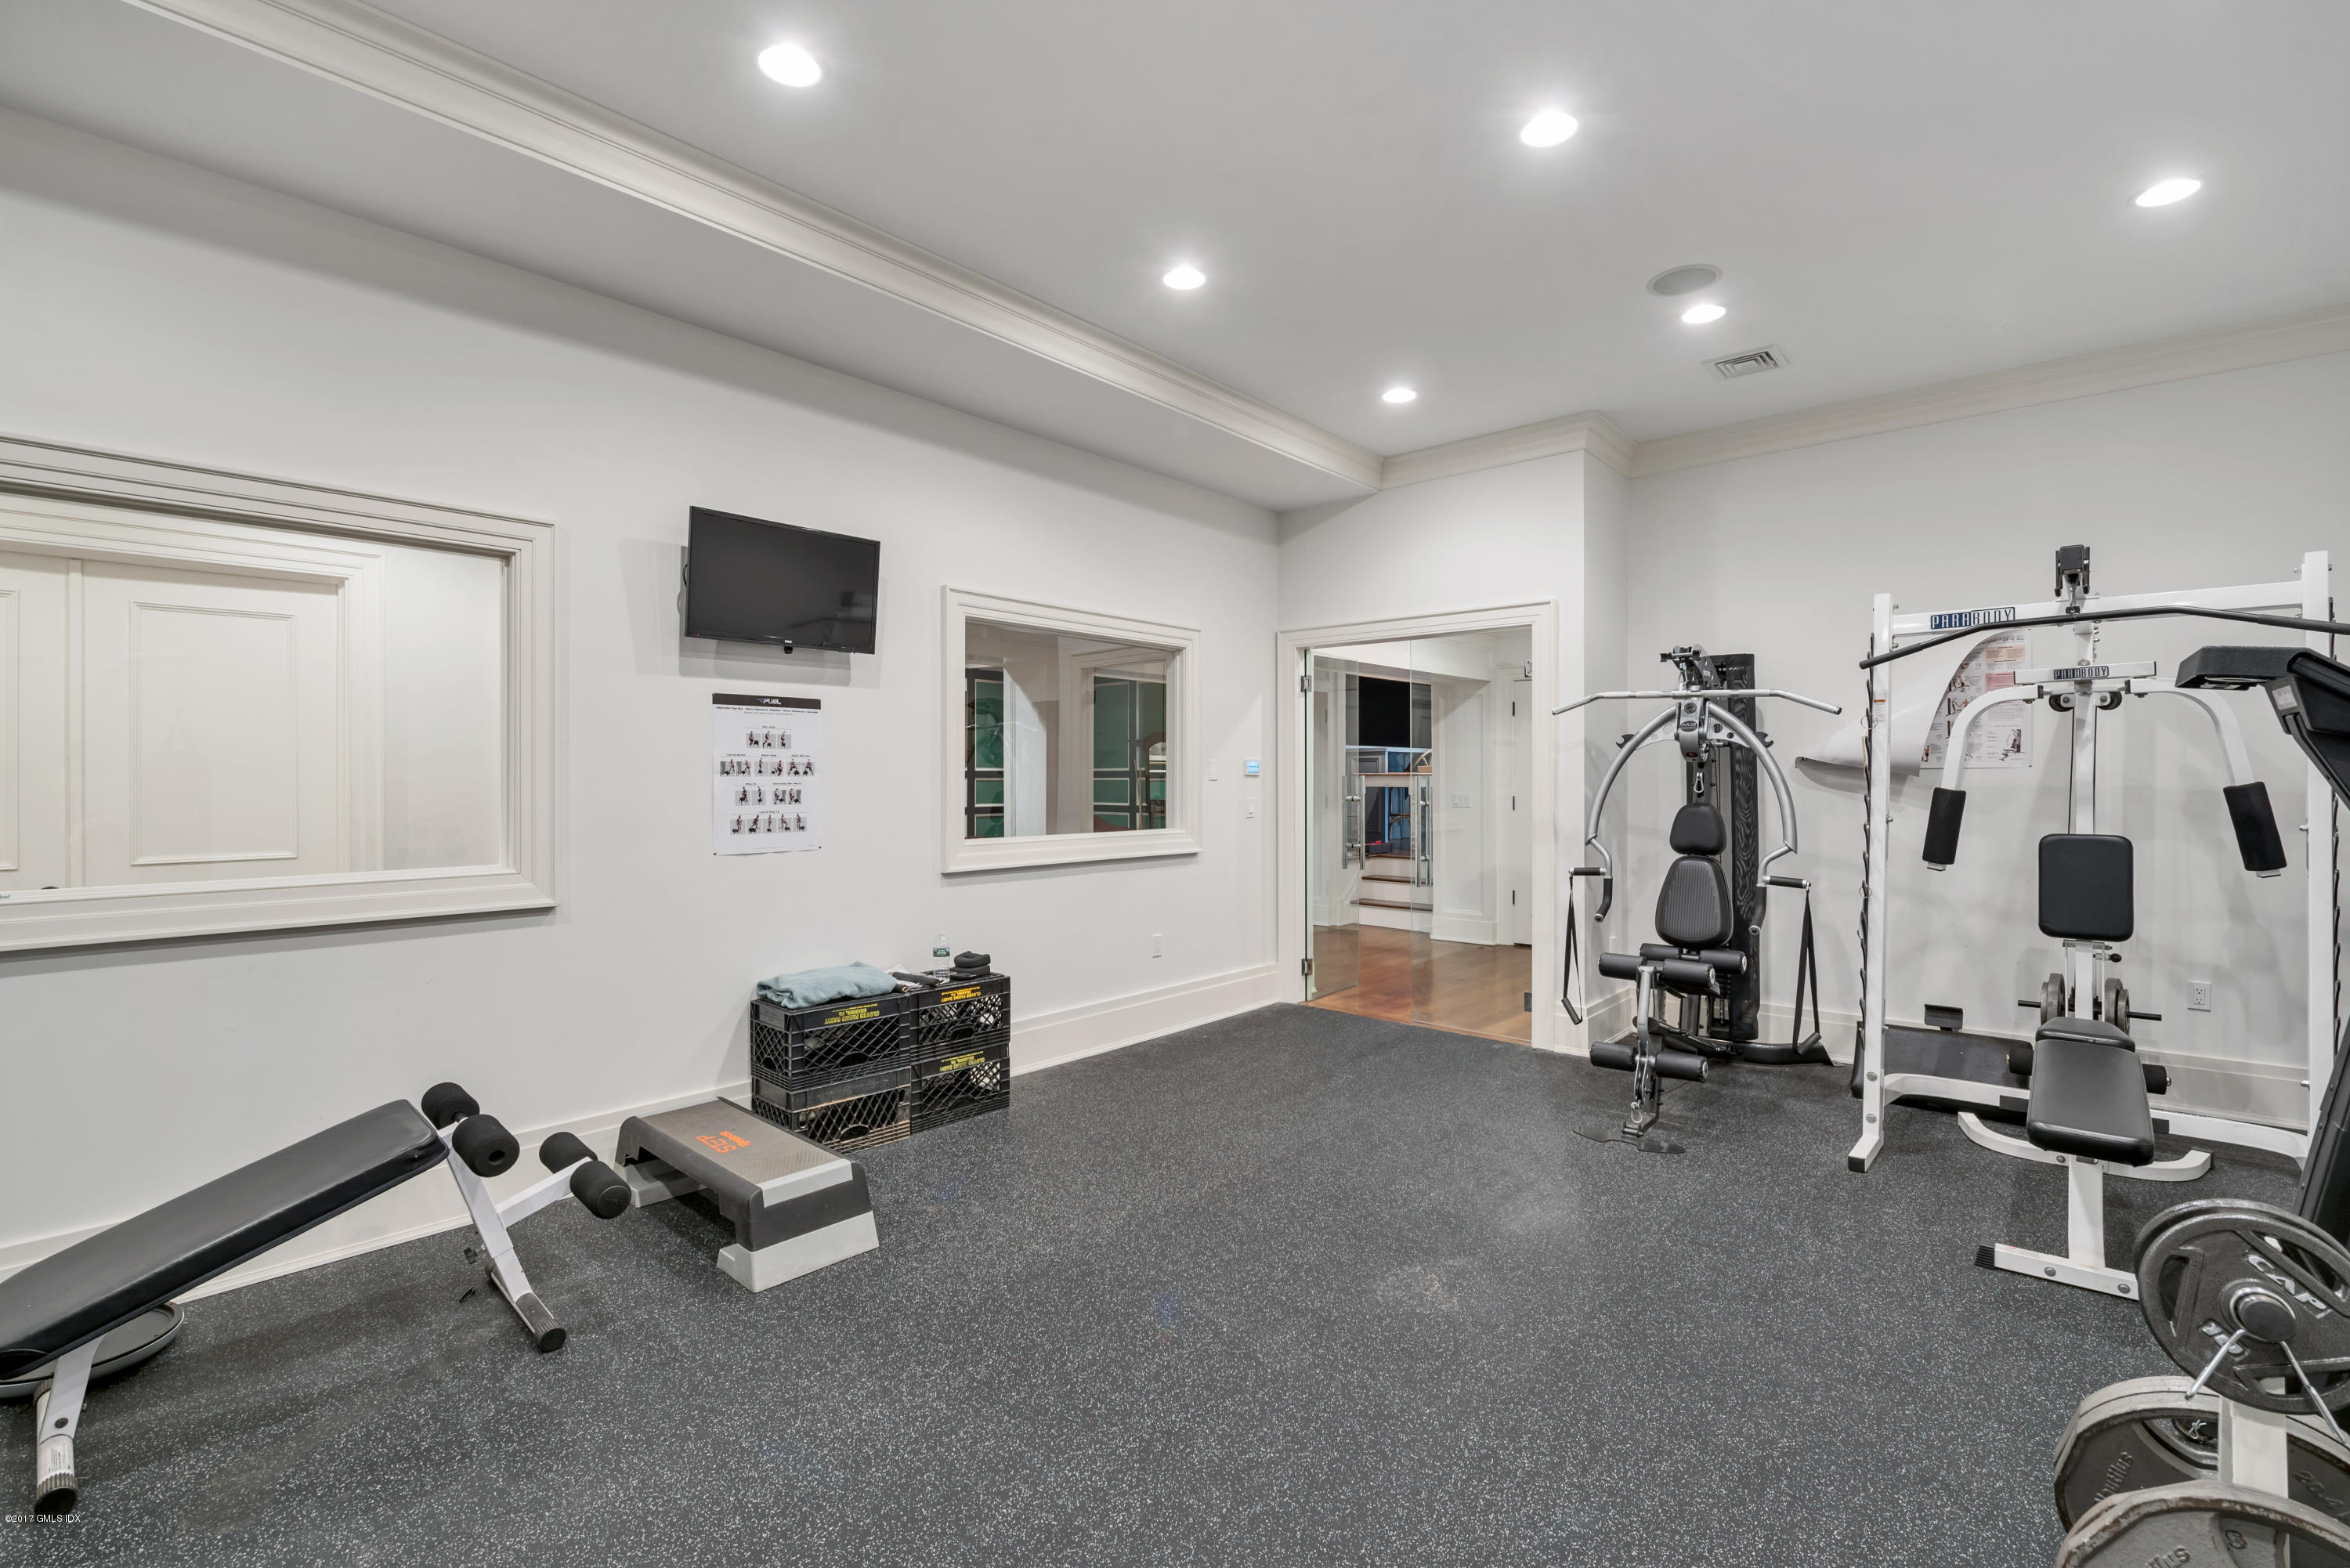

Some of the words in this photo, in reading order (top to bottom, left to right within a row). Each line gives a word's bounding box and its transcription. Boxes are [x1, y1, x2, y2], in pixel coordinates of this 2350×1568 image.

[1932, 609, 2014, 629] PARABODY
[2055, 667, 2108, 679] PARABODY
[696, 1135, 736, 1153] STEP
[2247, 1254, 2327, 1310] CAP
